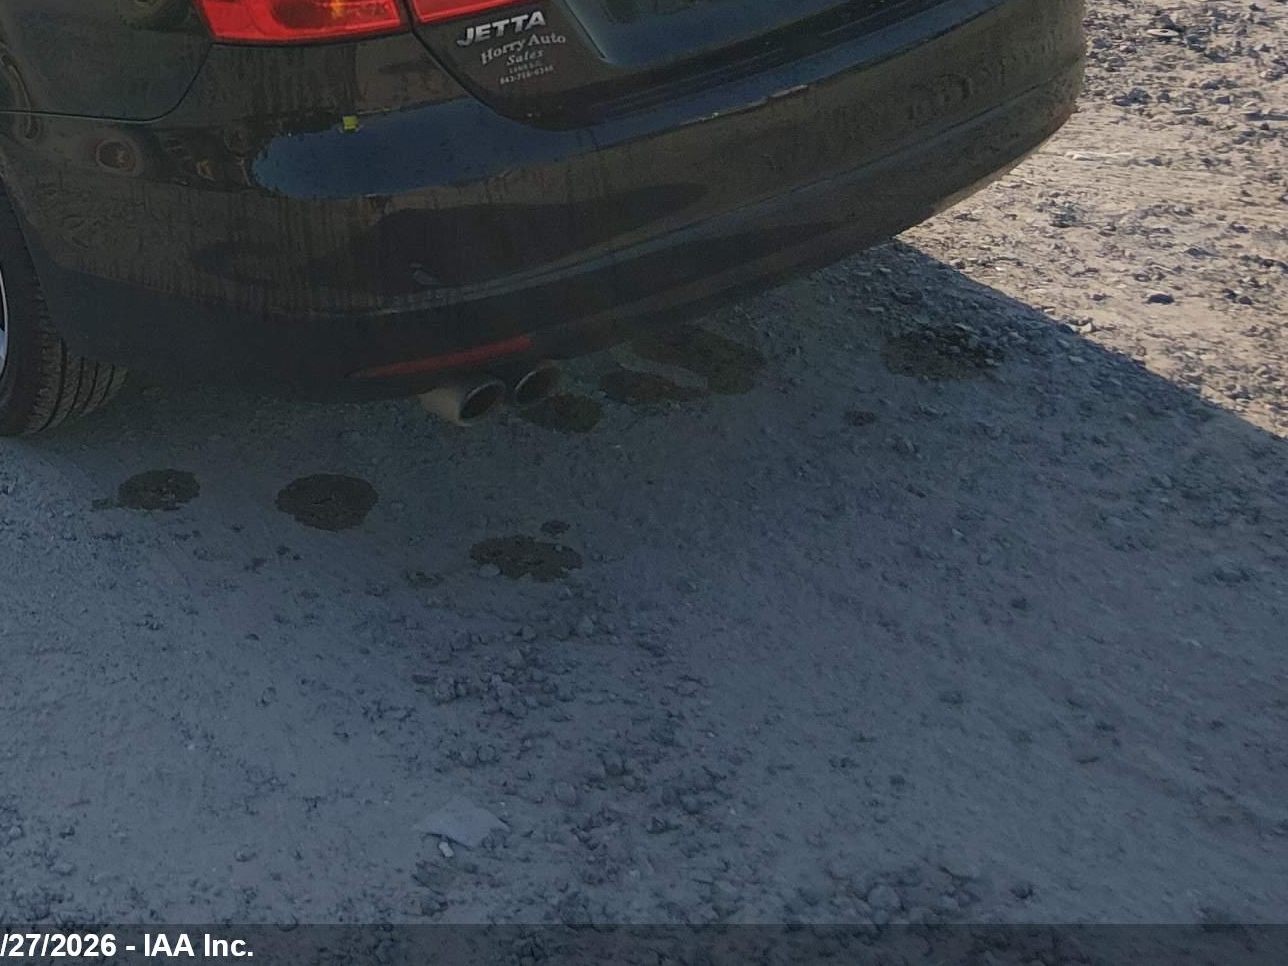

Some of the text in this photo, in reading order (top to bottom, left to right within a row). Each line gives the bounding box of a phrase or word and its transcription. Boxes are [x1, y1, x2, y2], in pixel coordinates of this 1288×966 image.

[456, 10, 547, 46] JETTA
[480, 31, 567, 66] Horry Auto
[506, 49, 545, 67] Sales
